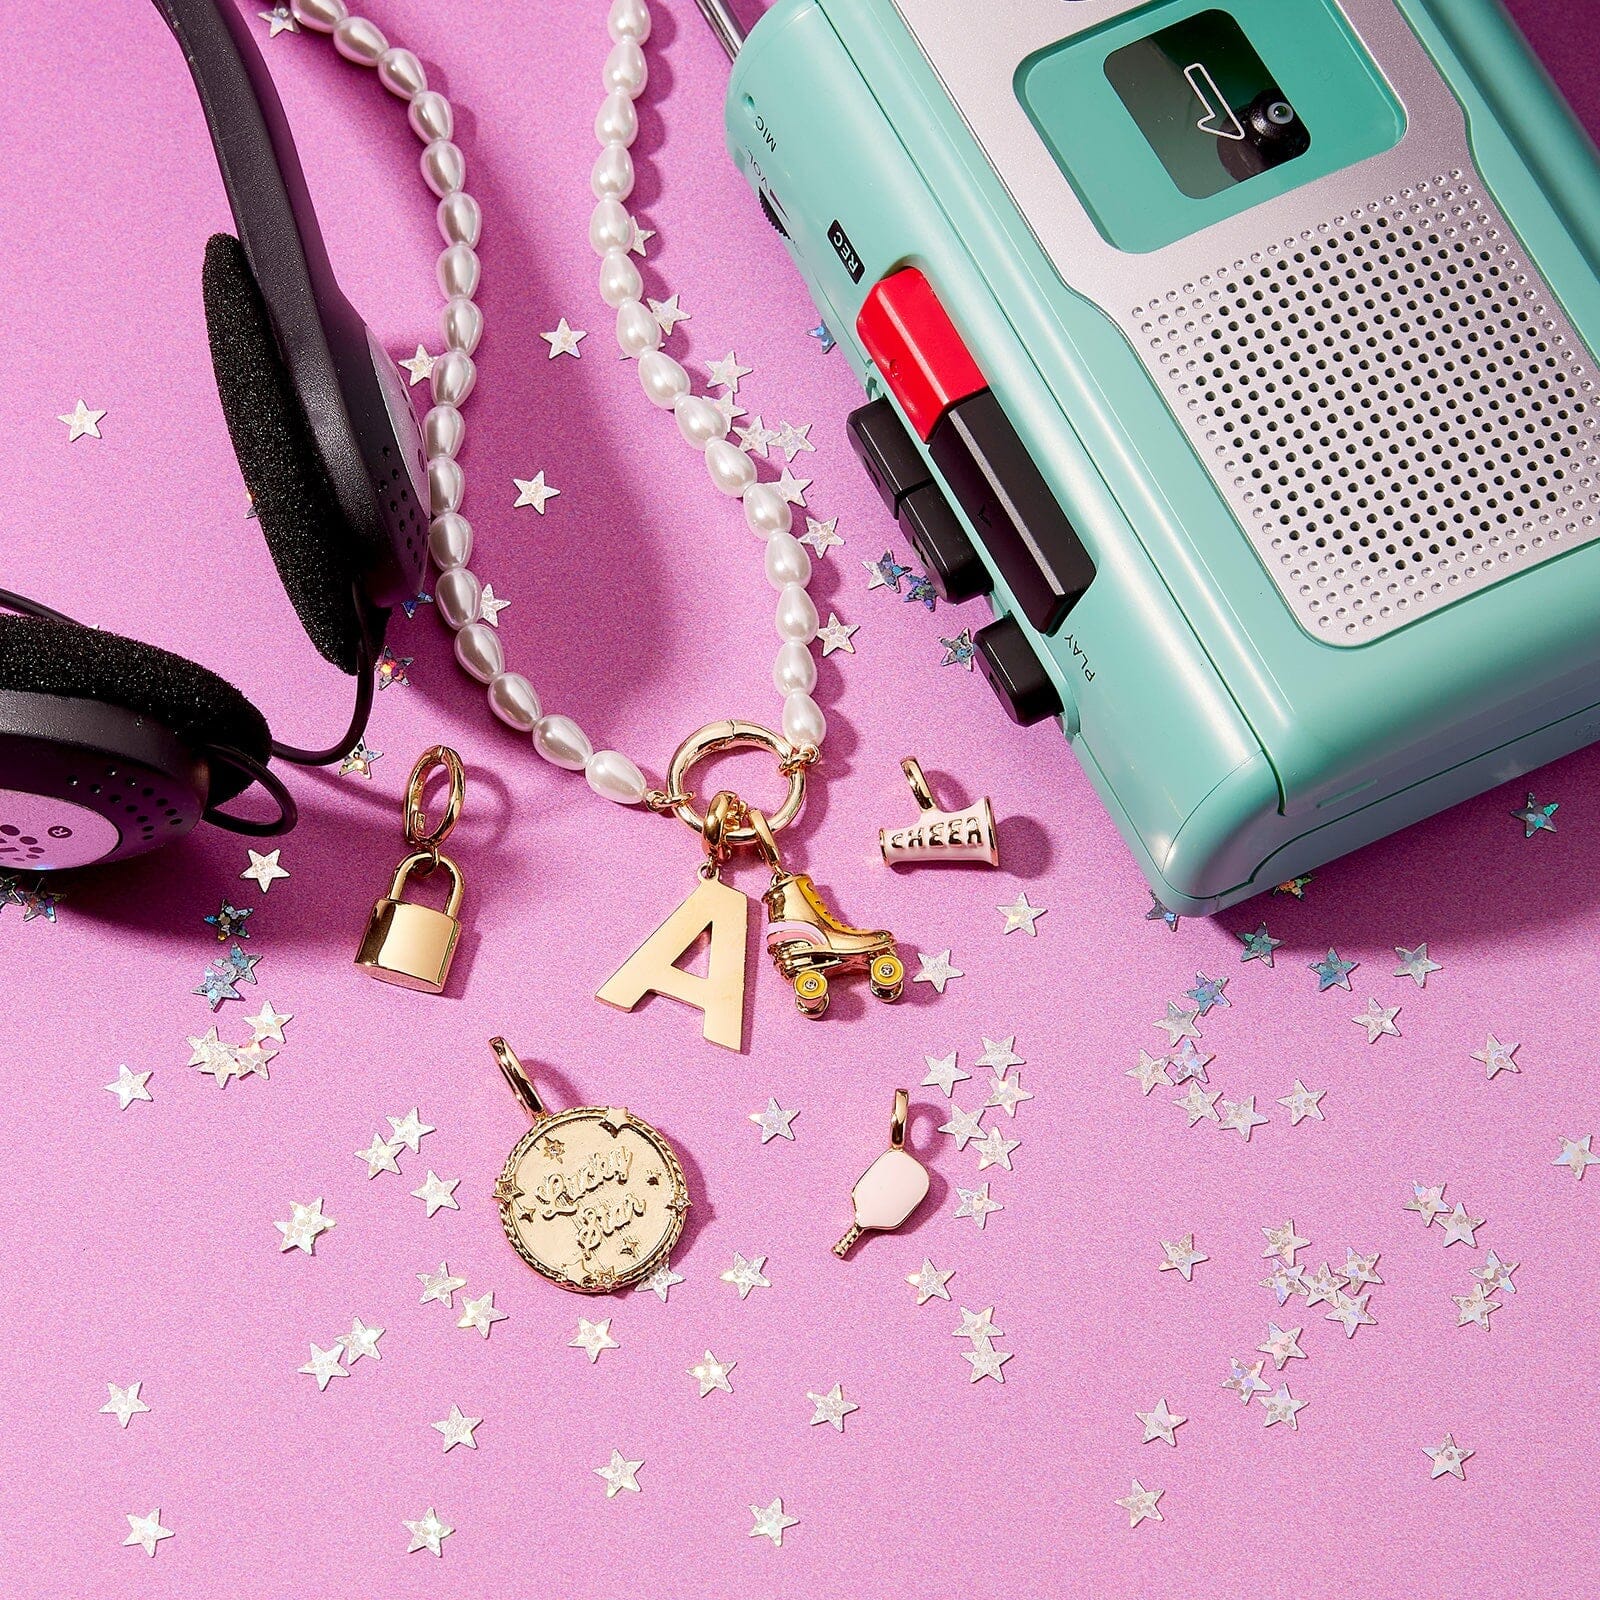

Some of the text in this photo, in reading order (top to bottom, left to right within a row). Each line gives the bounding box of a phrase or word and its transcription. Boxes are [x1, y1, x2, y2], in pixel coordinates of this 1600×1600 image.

[755, 115, 777, 153] MIC
[833, 231, 859, 274] REC
[1064, 634, 1096, 682] PLAY
[594, 878, 748, 1052] A
[535, 1145, 633, 1221] Lucky
[577, 1193, 647, 1261] Star
